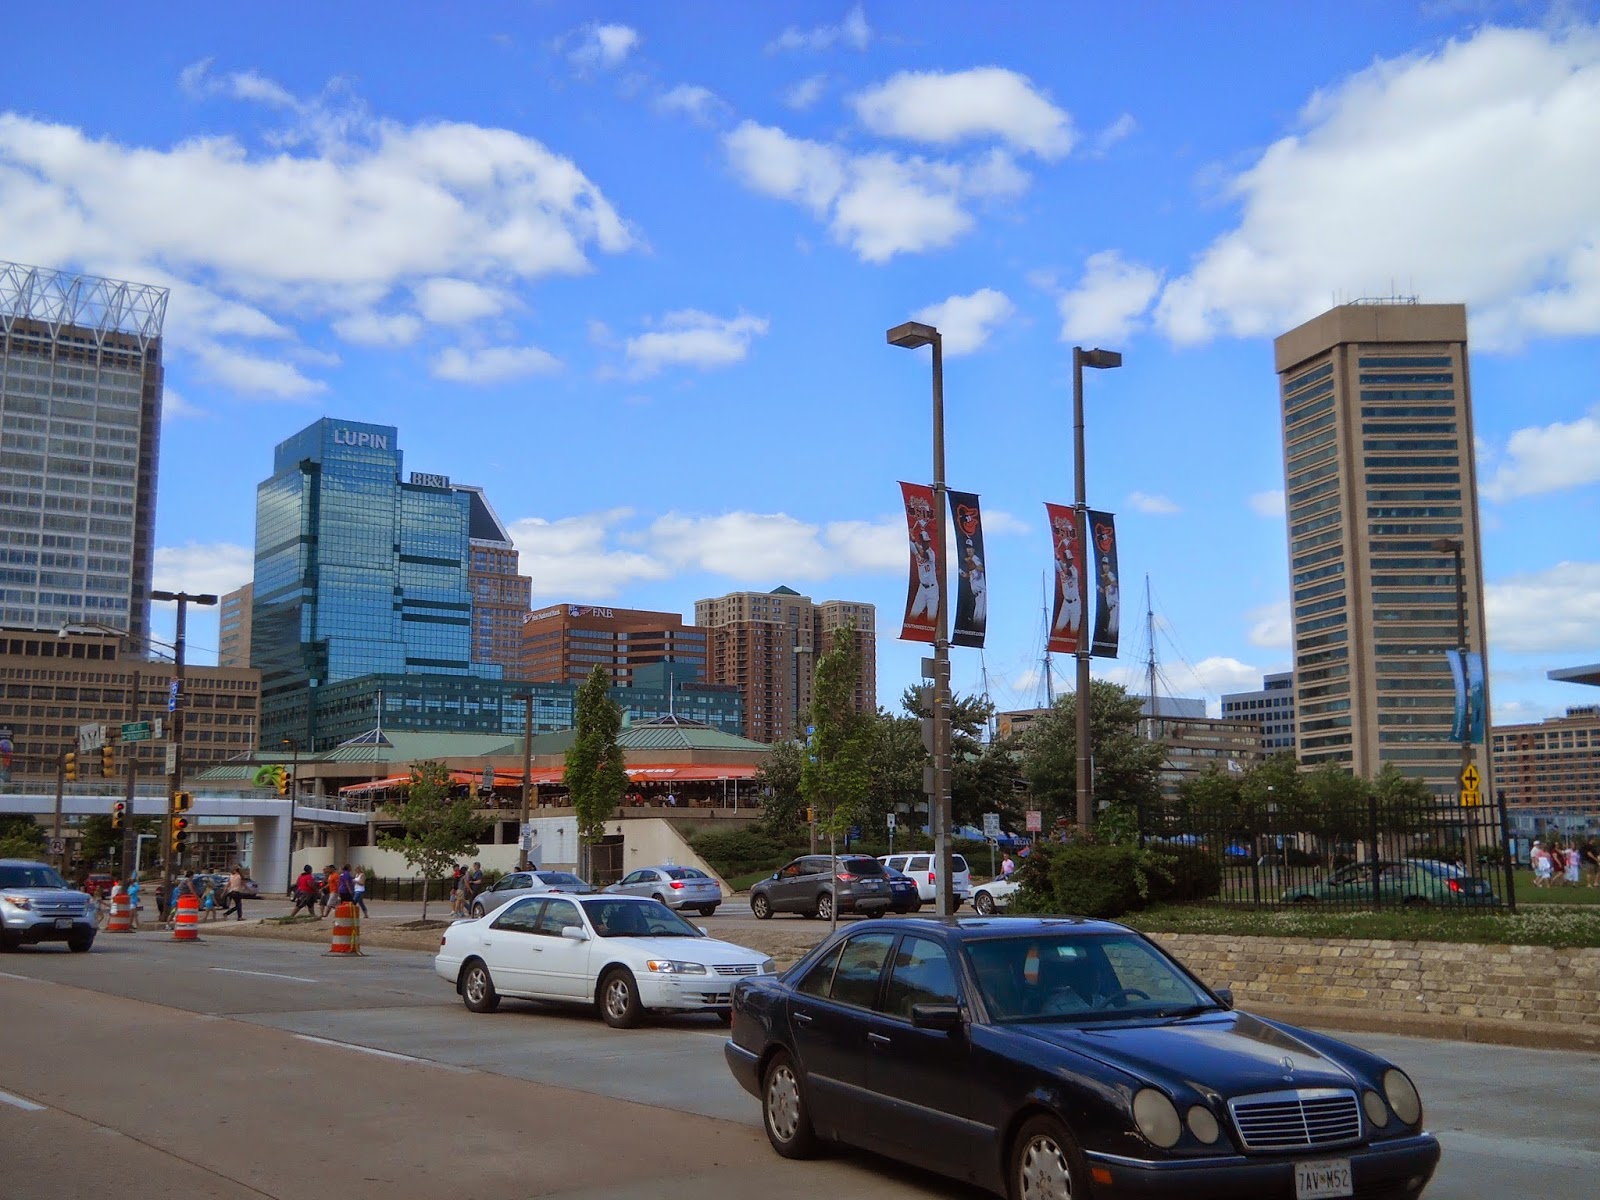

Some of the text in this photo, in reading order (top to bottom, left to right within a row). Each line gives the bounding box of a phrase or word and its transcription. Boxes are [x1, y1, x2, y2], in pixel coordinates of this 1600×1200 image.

[334, 429, 387, 450] LUPIN
[412, 472, 446, 489] BB&T
[903, 623, 936, 631] SOUTHWEST.COM
